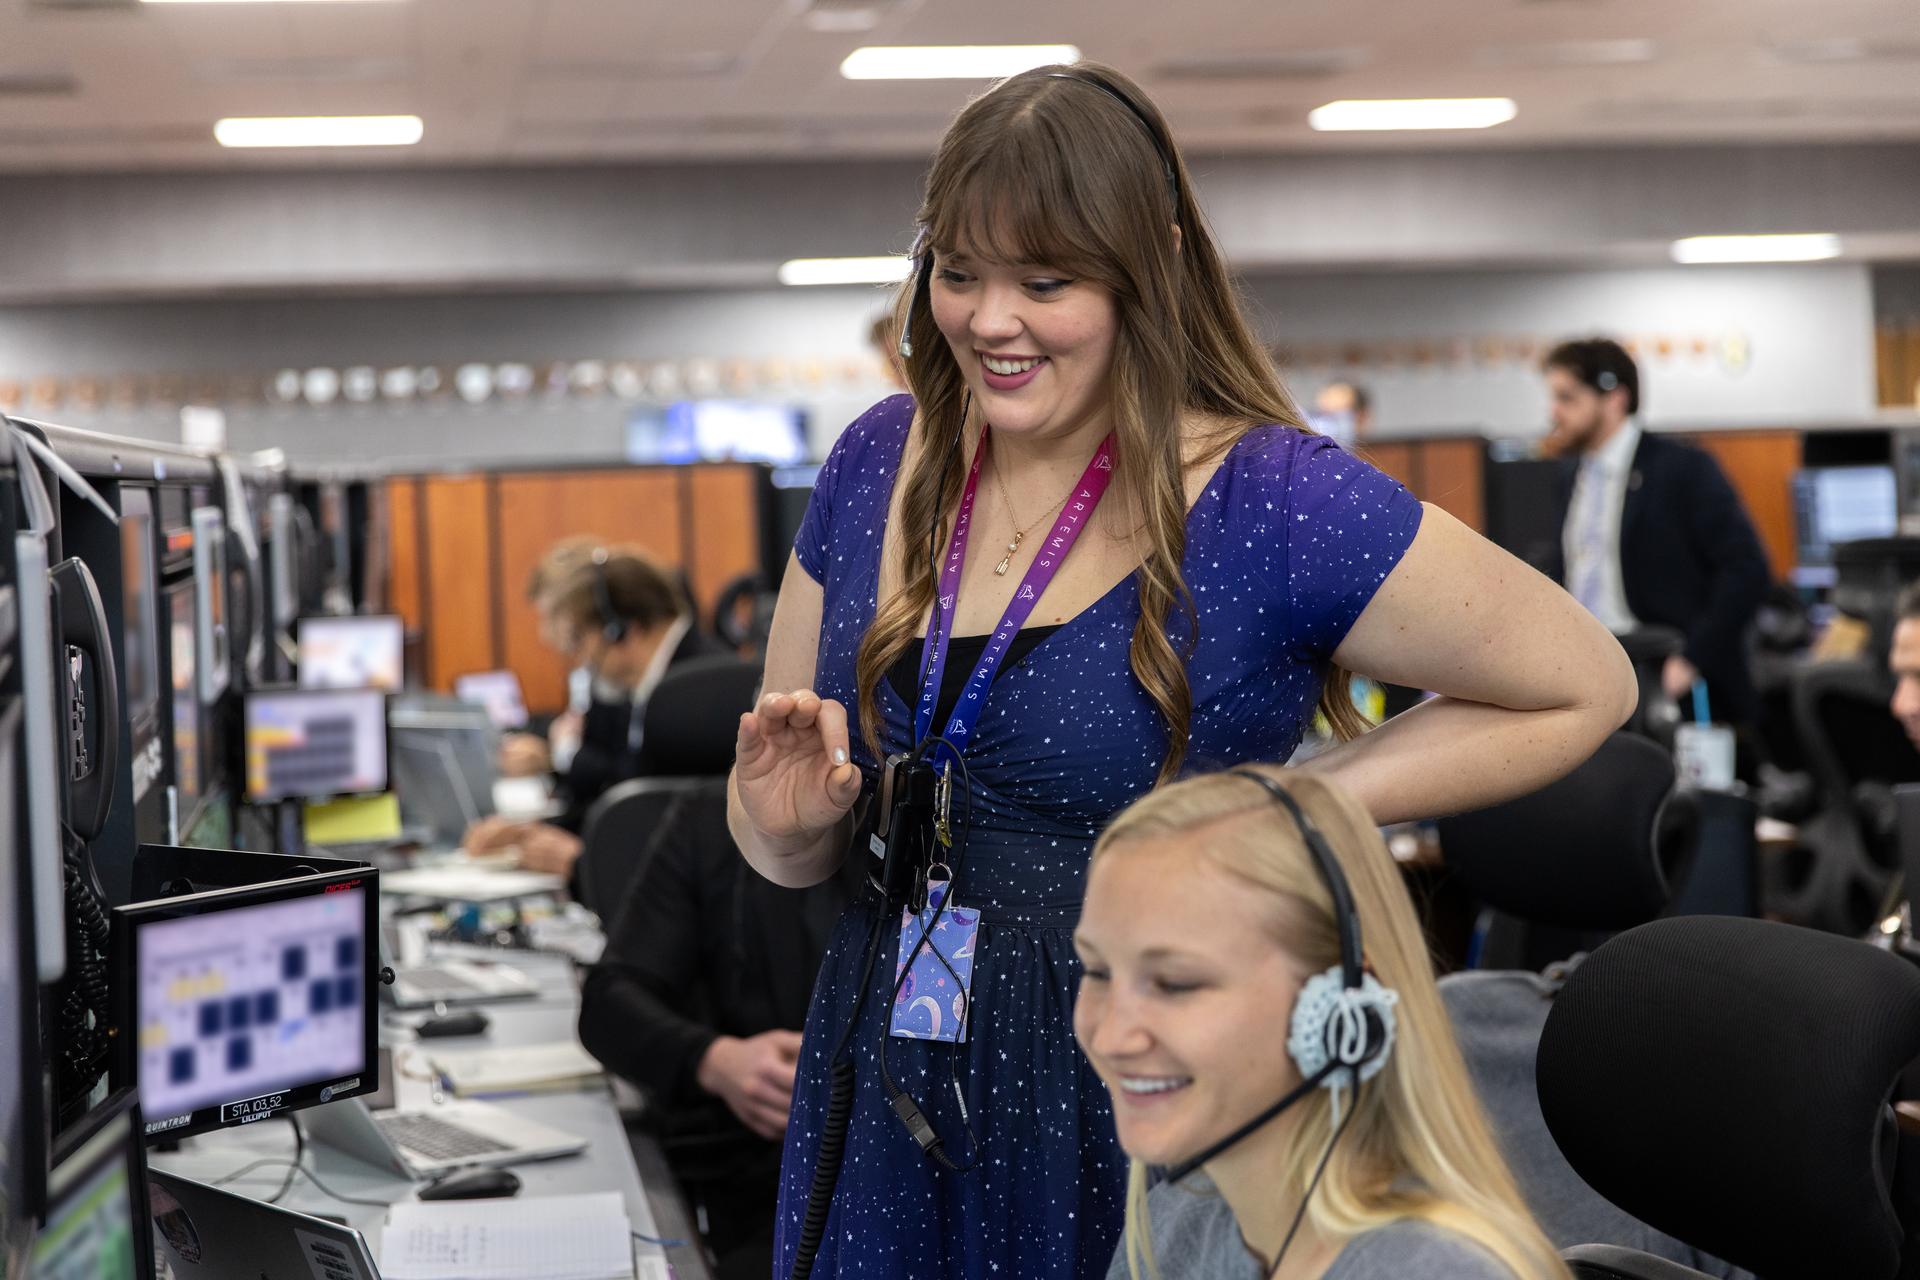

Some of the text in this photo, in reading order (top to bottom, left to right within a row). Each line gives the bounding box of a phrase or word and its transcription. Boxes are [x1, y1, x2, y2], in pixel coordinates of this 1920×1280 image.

[949, 493, 973, 573] ARTEMIS
[1040, 489, 1092, 568] ARTEMIS
[967, 619, 1014, 700] ARTEMIS
[146, 1115, 191, 1132] QUINTRON
[232, 1103, 250, 1117] STA
